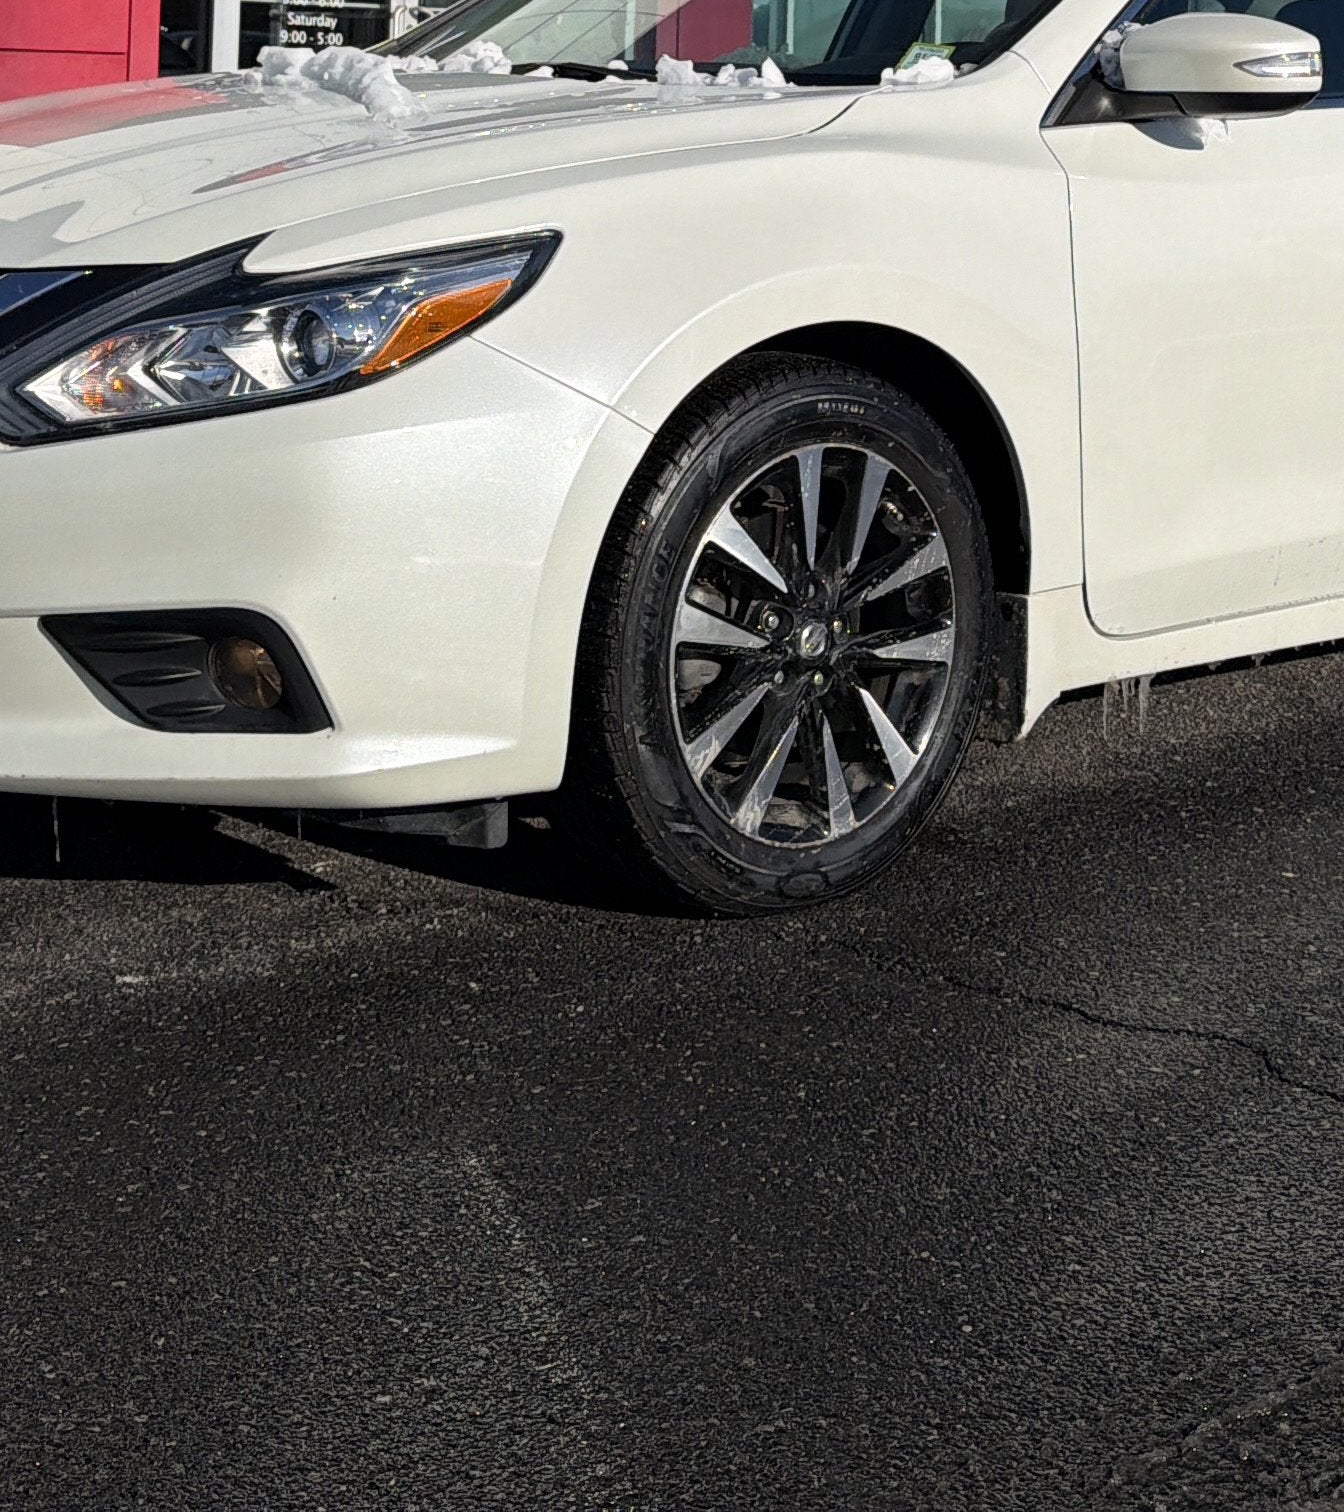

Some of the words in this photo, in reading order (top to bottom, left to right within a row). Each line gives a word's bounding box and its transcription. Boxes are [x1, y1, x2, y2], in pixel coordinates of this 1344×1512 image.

[287, 12, 338, 30] Saturday
[279, 30, 307, 44] 9:00
[317, 32, 343, 45] 5:00
